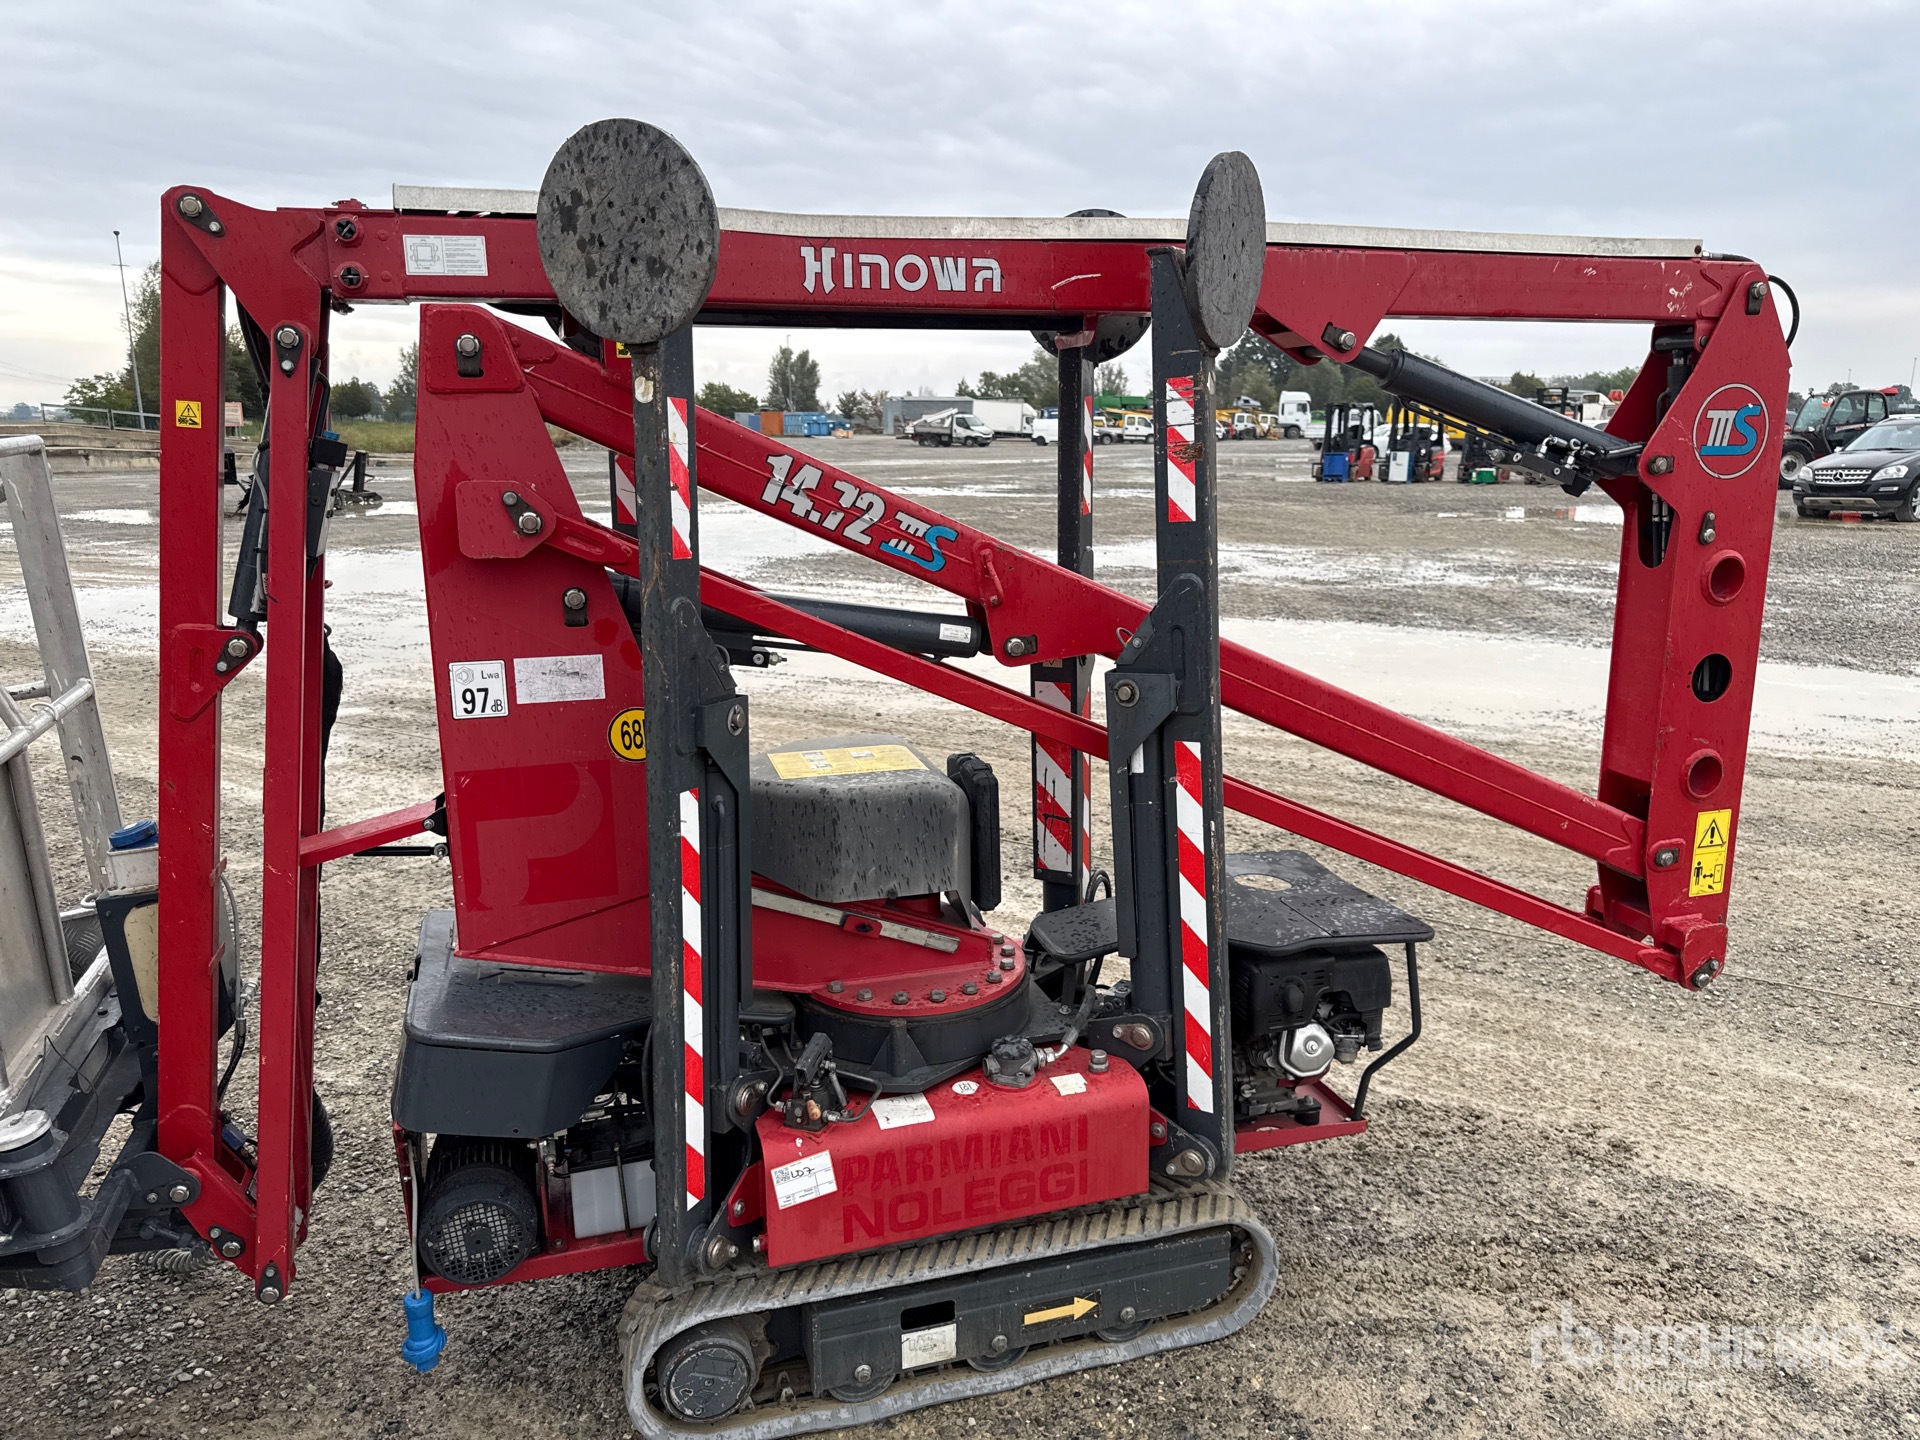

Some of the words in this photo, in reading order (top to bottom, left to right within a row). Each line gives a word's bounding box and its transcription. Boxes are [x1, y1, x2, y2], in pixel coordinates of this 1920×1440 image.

[461, 687, 490, 715] 97
[490, 698, 504, 713] dB
[620, 718, 647, 751] 68
[841, 1113, 1089, 1197] PARMIANI
[843, 1158, 1089, 1244] NOLEGGI
